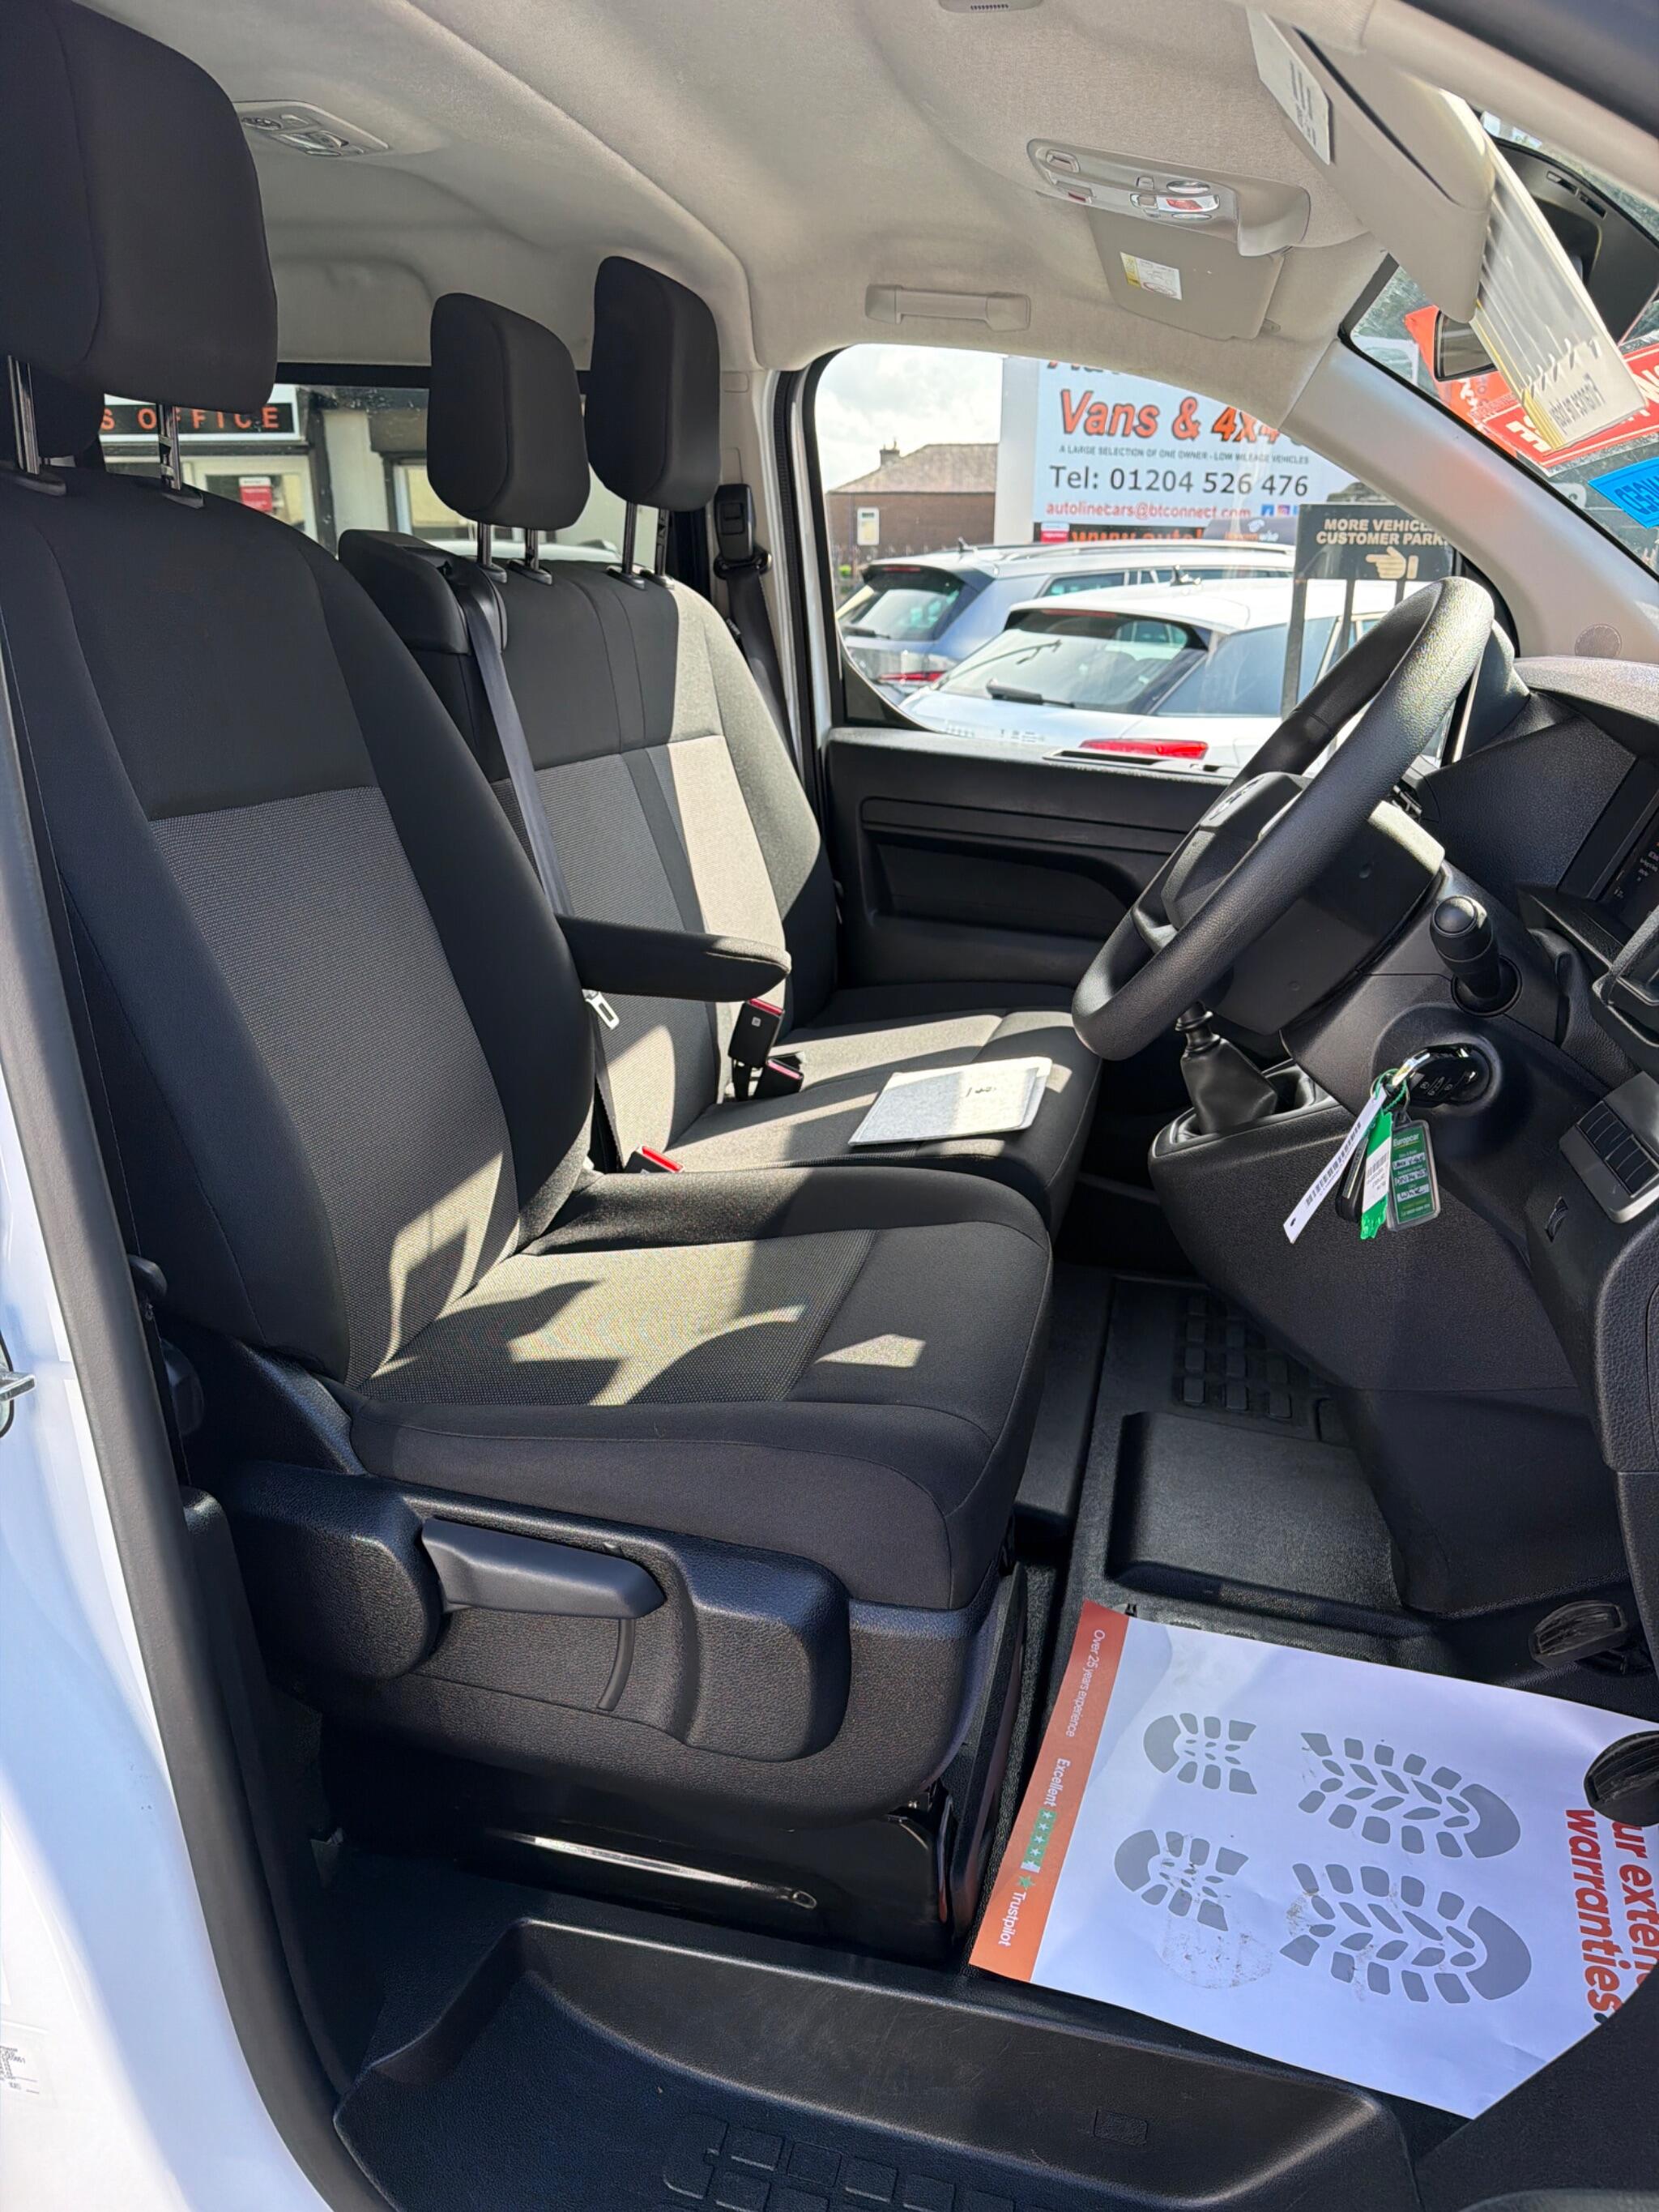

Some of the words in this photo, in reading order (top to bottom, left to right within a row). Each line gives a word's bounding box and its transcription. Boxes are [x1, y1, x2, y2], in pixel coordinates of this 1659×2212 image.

[1060, 388, 1161, 438] Vans
[1171, 396, 1201, 441] &
[1068, 445, 1096, 455] LARGE
[1098, 446, 1144, 458] SELECTION
[1178, 450, 1208, 460] OWNER
[1214, 451, 1234, 461] LOW
[1235, 451, 1270, 463] MILEAGE
[1271, 454, 1310, 465] VEHICLES
[1050, 465, 1098, 489] Tel:
[1110, 468, 1194, 493] 01204
[1202, 472, 1253, 495] 526
[1260, 474, 1309, 497] 476
[1316, 532, 1400, 545] CUSTOMER
[1324, 519, 1369, 532] MORE
[1372, 519, 1433, 532] VEHICL
[1090, 1629, 1106, 1654] Over
[1086, 1653, 1100, 1669] 25
[1082, 1667, 1094, 1691] years
[1065, 1690, 1087, 1737] experience
[1043, 1757, 1071, 1807] Excellent
[998, 1891, 1027, 1947] Trustpilot
[1618, 1864, 1659, 1985] exten
